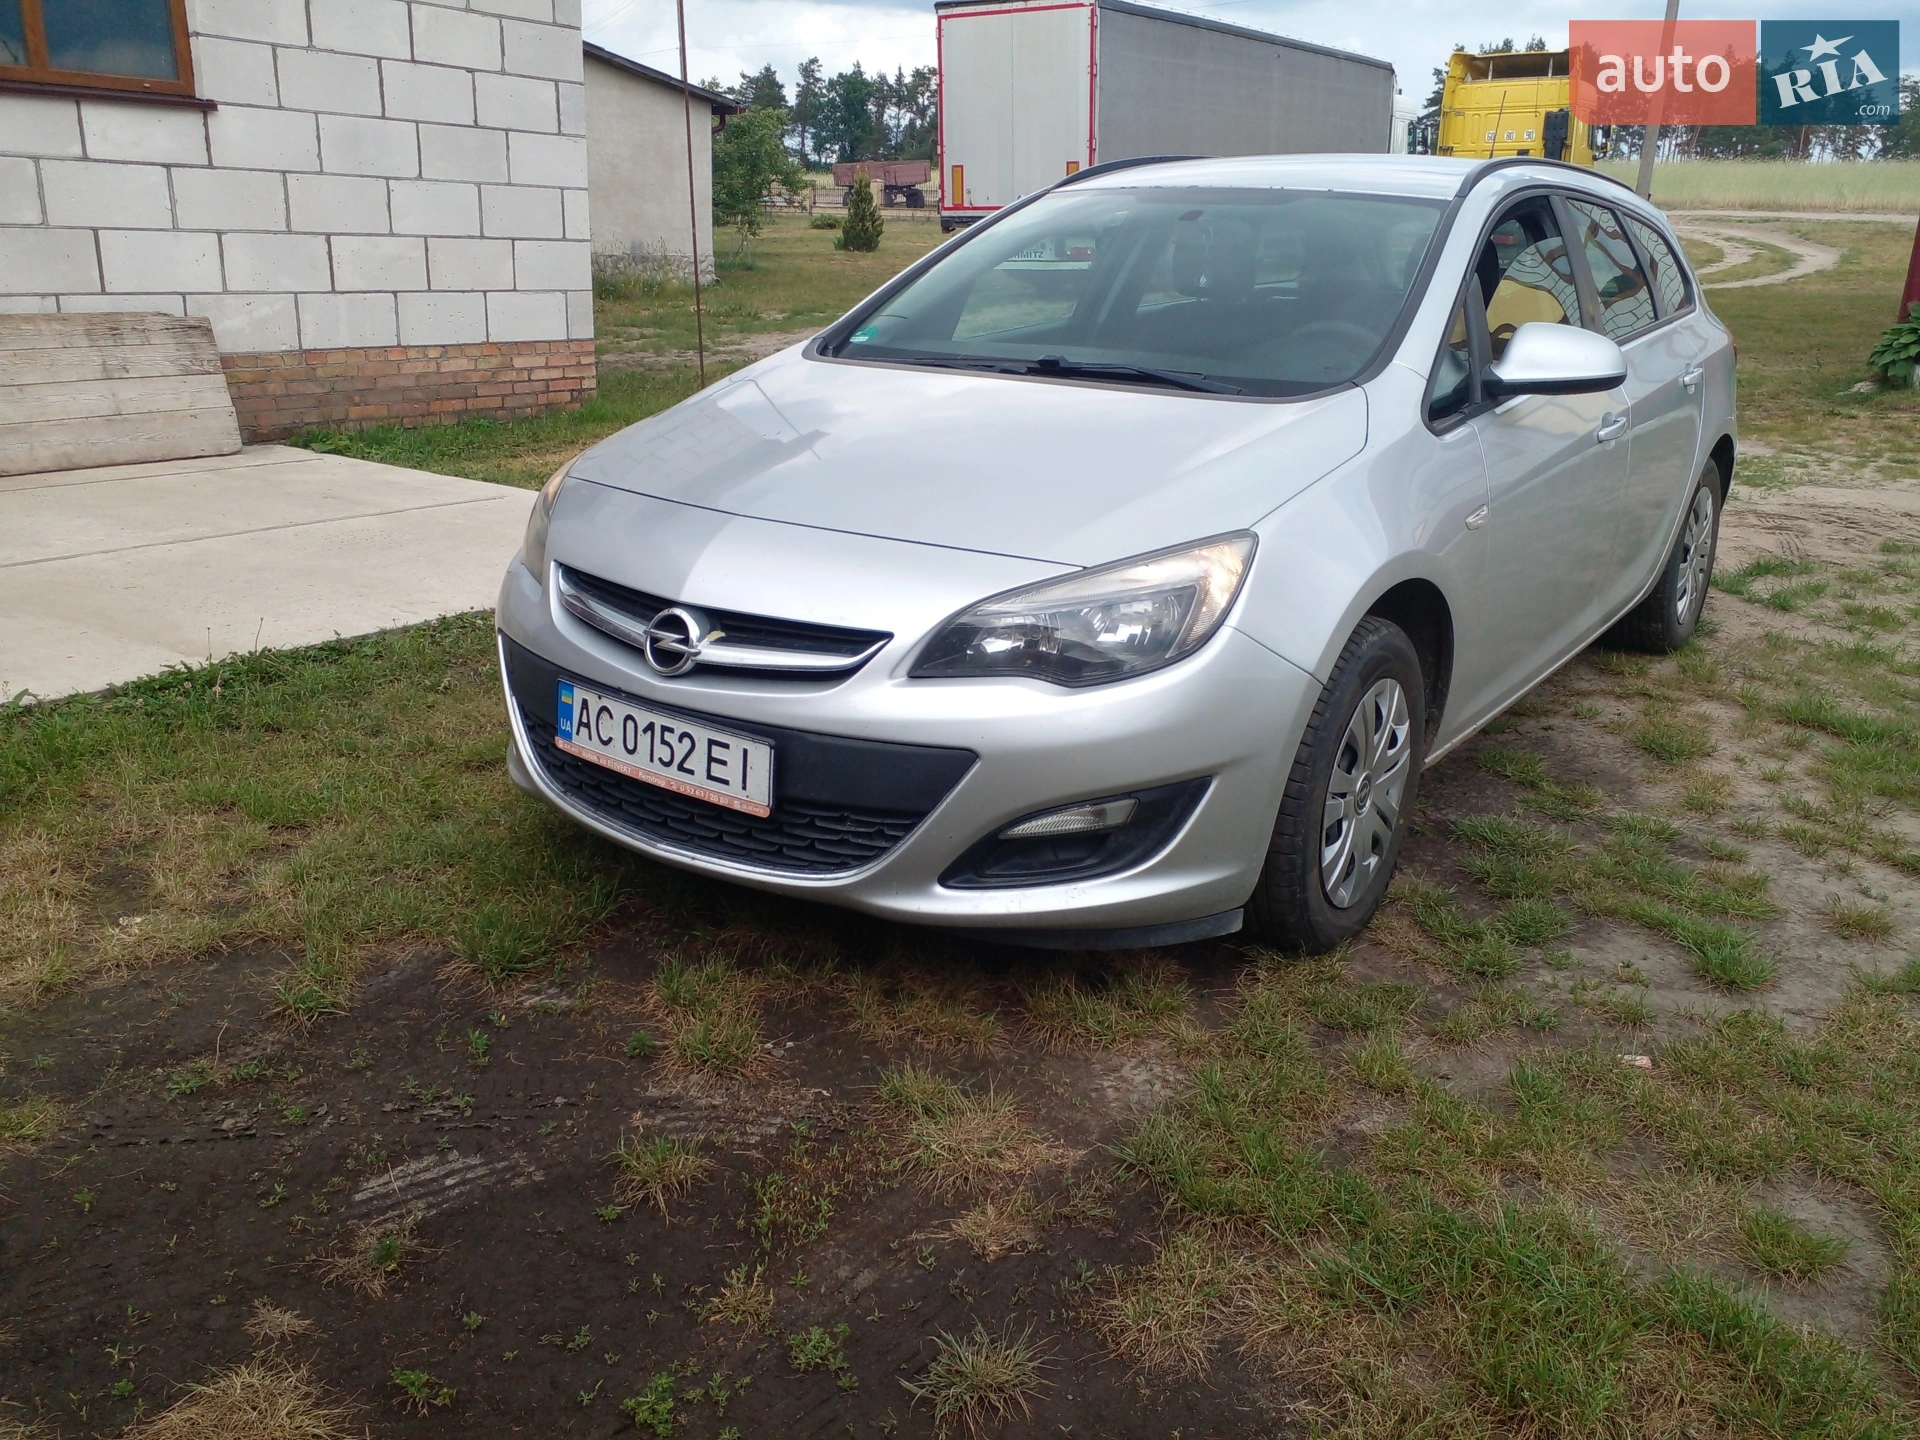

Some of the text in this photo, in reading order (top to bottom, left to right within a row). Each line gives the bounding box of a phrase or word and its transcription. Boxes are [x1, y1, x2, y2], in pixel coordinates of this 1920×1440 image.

[560, 718, 572, 733] UA
[575, 697, 748, 791] AC 0152 EI
